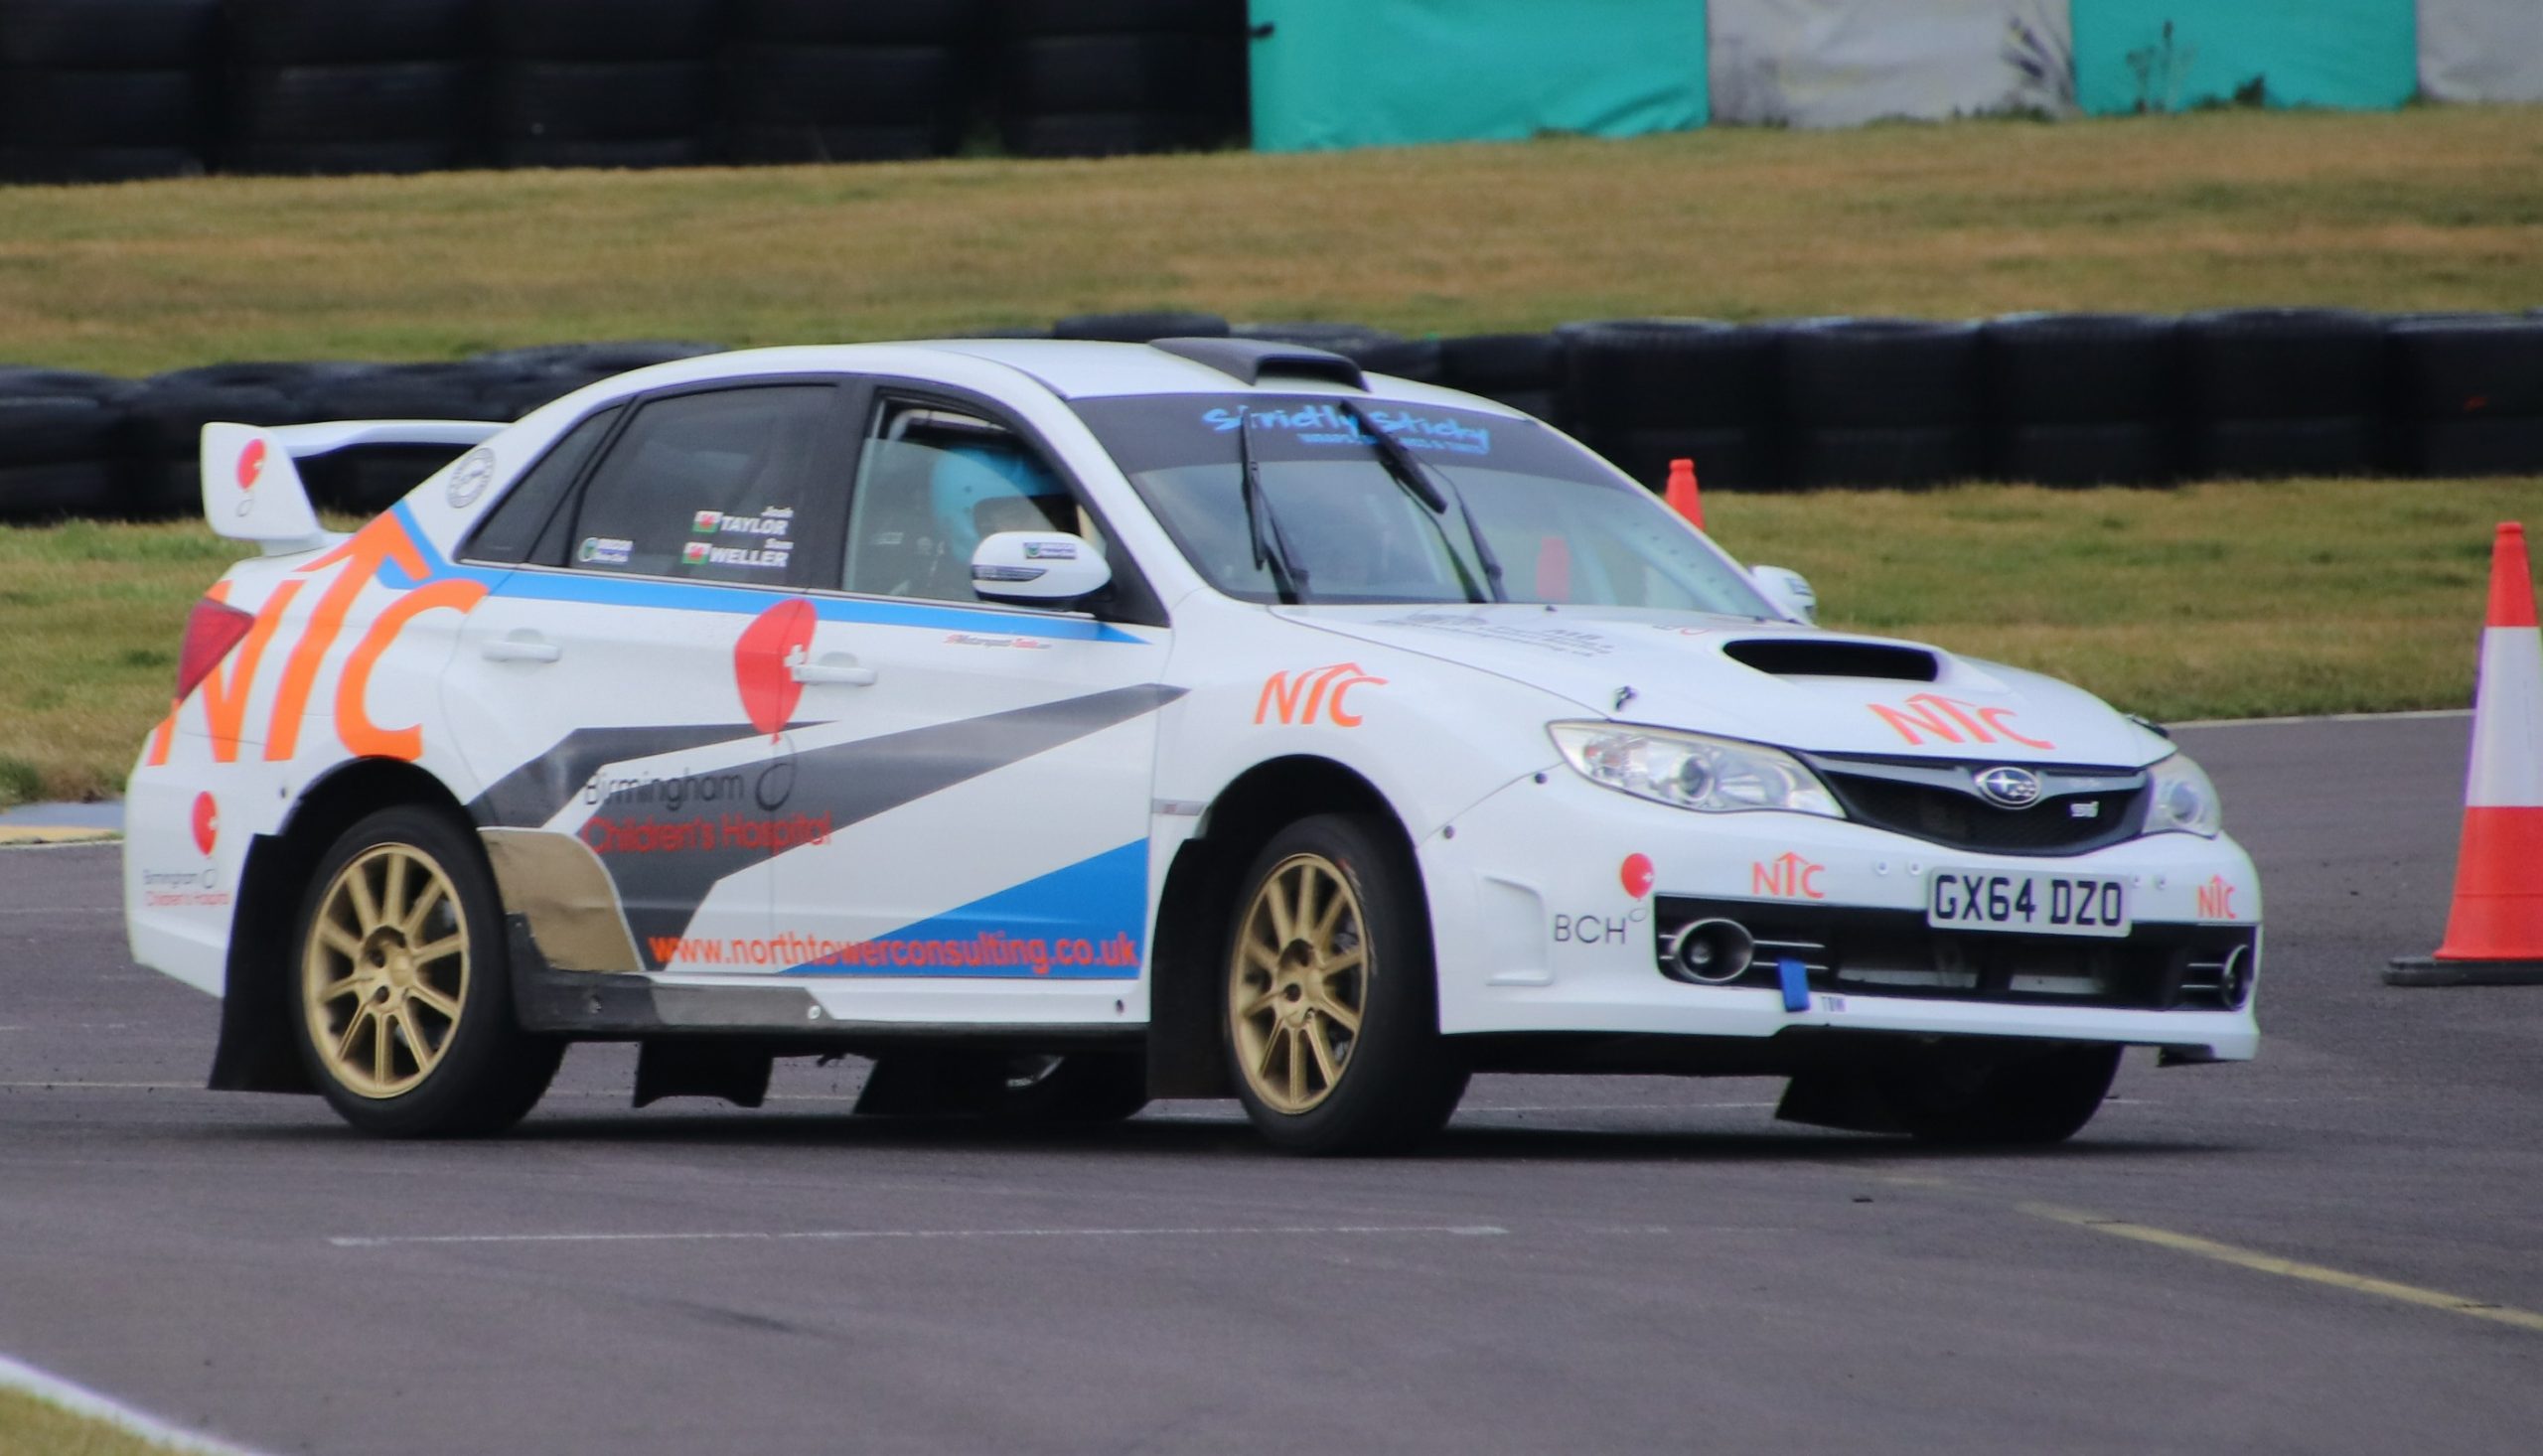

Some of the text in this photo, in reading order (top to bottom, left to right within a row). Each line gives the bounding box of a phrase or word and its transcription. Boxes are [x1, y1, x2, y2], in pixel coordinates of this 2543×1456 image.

[720, 515, 789, 535] TAYLOR
[709, 546, 789, 567] WELLER
[147, 509, 490, 767] NTC
[1253, 661, 1390, 728] NTC
[1867, 692, 2056, 750] NTC
[585, 767, 742, 812] Birmingham
[580, 808, 832, 857] Children's Hospital
[1752, 851, 1826, 899] NTC
[2196, 874, 2237, 920] NTC
[1935, 874, 2122, 927] GX64 DZO
[1554, 913, 1627, 944] BCH
[648, 931, 1140, 974] www.northtowerconsulting.co.uk
